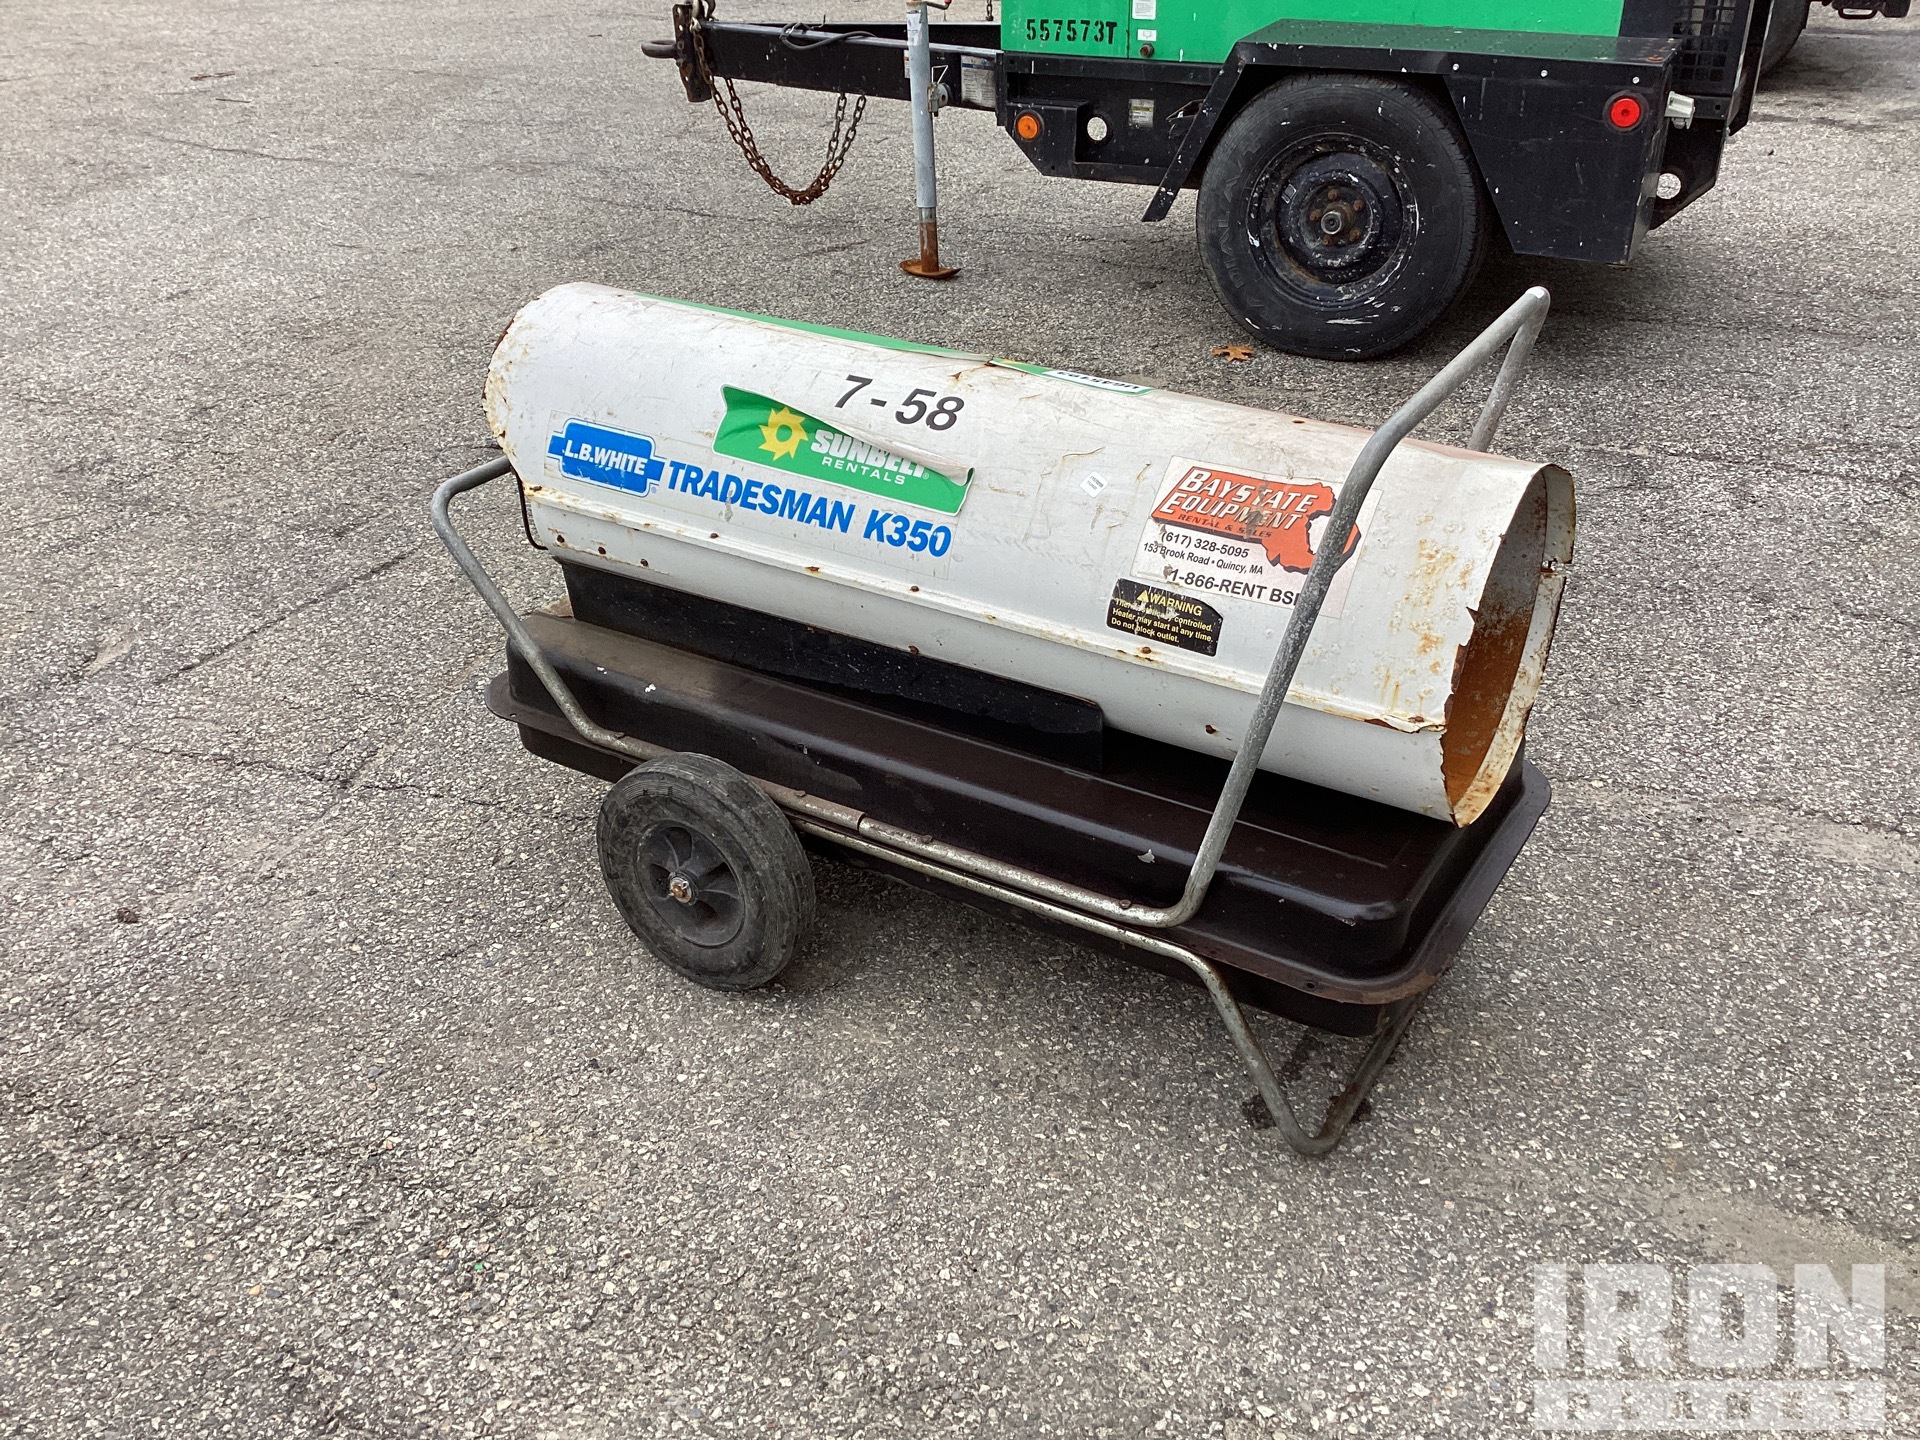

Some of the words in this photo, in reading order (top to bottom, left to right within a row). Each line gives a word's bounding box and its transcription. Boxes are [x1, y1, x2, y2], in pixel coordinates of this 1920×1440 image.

[1026, 19, 1117, 44] 557573T
[822, 457, 905, 485] RENTALS
[1178, 469, 1319, 513] BAYSTATE
[667, 460, 856, 533] TRADESMAN
[863, 509, 951, 557] K350
[1159, 491, 1302, 530] EQUIPMENT
[1178, 514, 1220, 528] RENTAL
[1239, 527, 1273, 538] SLES
[1144, 542, 1158, 553] 153
[1160, 546, 1185, 559] Brook
[1187, 552, 1210, 565] Road
[1216, 559, 1247, 574] Quincy,
[1249, 564, 1263, 575] MA
[1161, 532, 1192, 549] (617)
[1194, 538, 1250, 558] 328-5095
[1171, 569, 1267, 599] 1-866-RENT
[1150, 593, 1203, 616] WARNING
[1111, 617, 1121, 626] Do
[1122, 622, 1135, 630] not
[1136, 625, 1155, 636] block
[1156, 631, 1180, 643] outlet.
[1112, 608, 1136, 620] Heater
[1136, 616, 1152, 626] may
[1153, 620, 1170, 631] start
[1171, 625, 1179, 633] at
[1180, 627, 1194, 638] any
[1195, 630, 1214, 643] time.
[1174, 616, 1213, 632] controlled.
